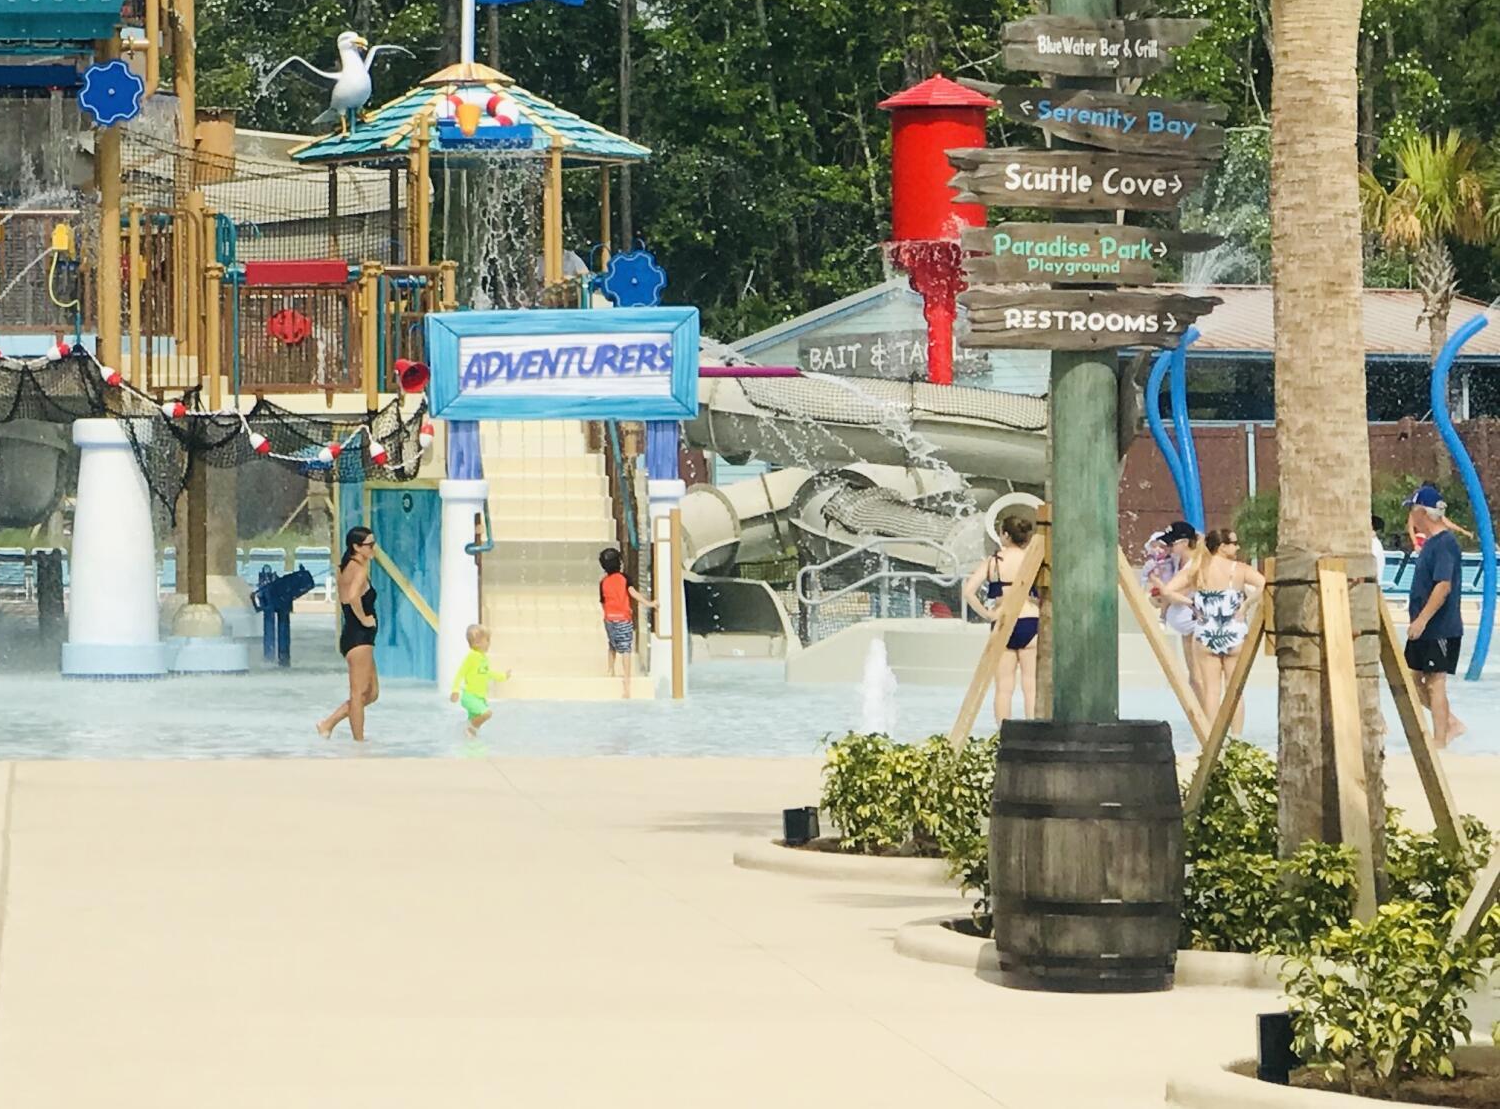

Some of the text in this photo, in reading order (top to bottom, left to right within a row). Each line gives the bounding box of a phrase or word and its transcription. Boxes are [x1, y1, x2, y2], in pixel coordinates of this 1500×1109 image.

[1037, 34, 1159, 58] BlueWater Bar & Grill
[1037, 100, 1198, 140] Serenity Bay
[1004, 163, 1168, 197] Scuttle Cove
[993, 233, 1153, 261] Paradise Park
[1027, 257, 1120, 276] Playground
[1004, 308, 1159, 333] RESTROOMS
[462, 342, 672, 390] ADVENTURERS
[809, 343, 861, 371] BAIT
[870, 338, 890, 372] &
